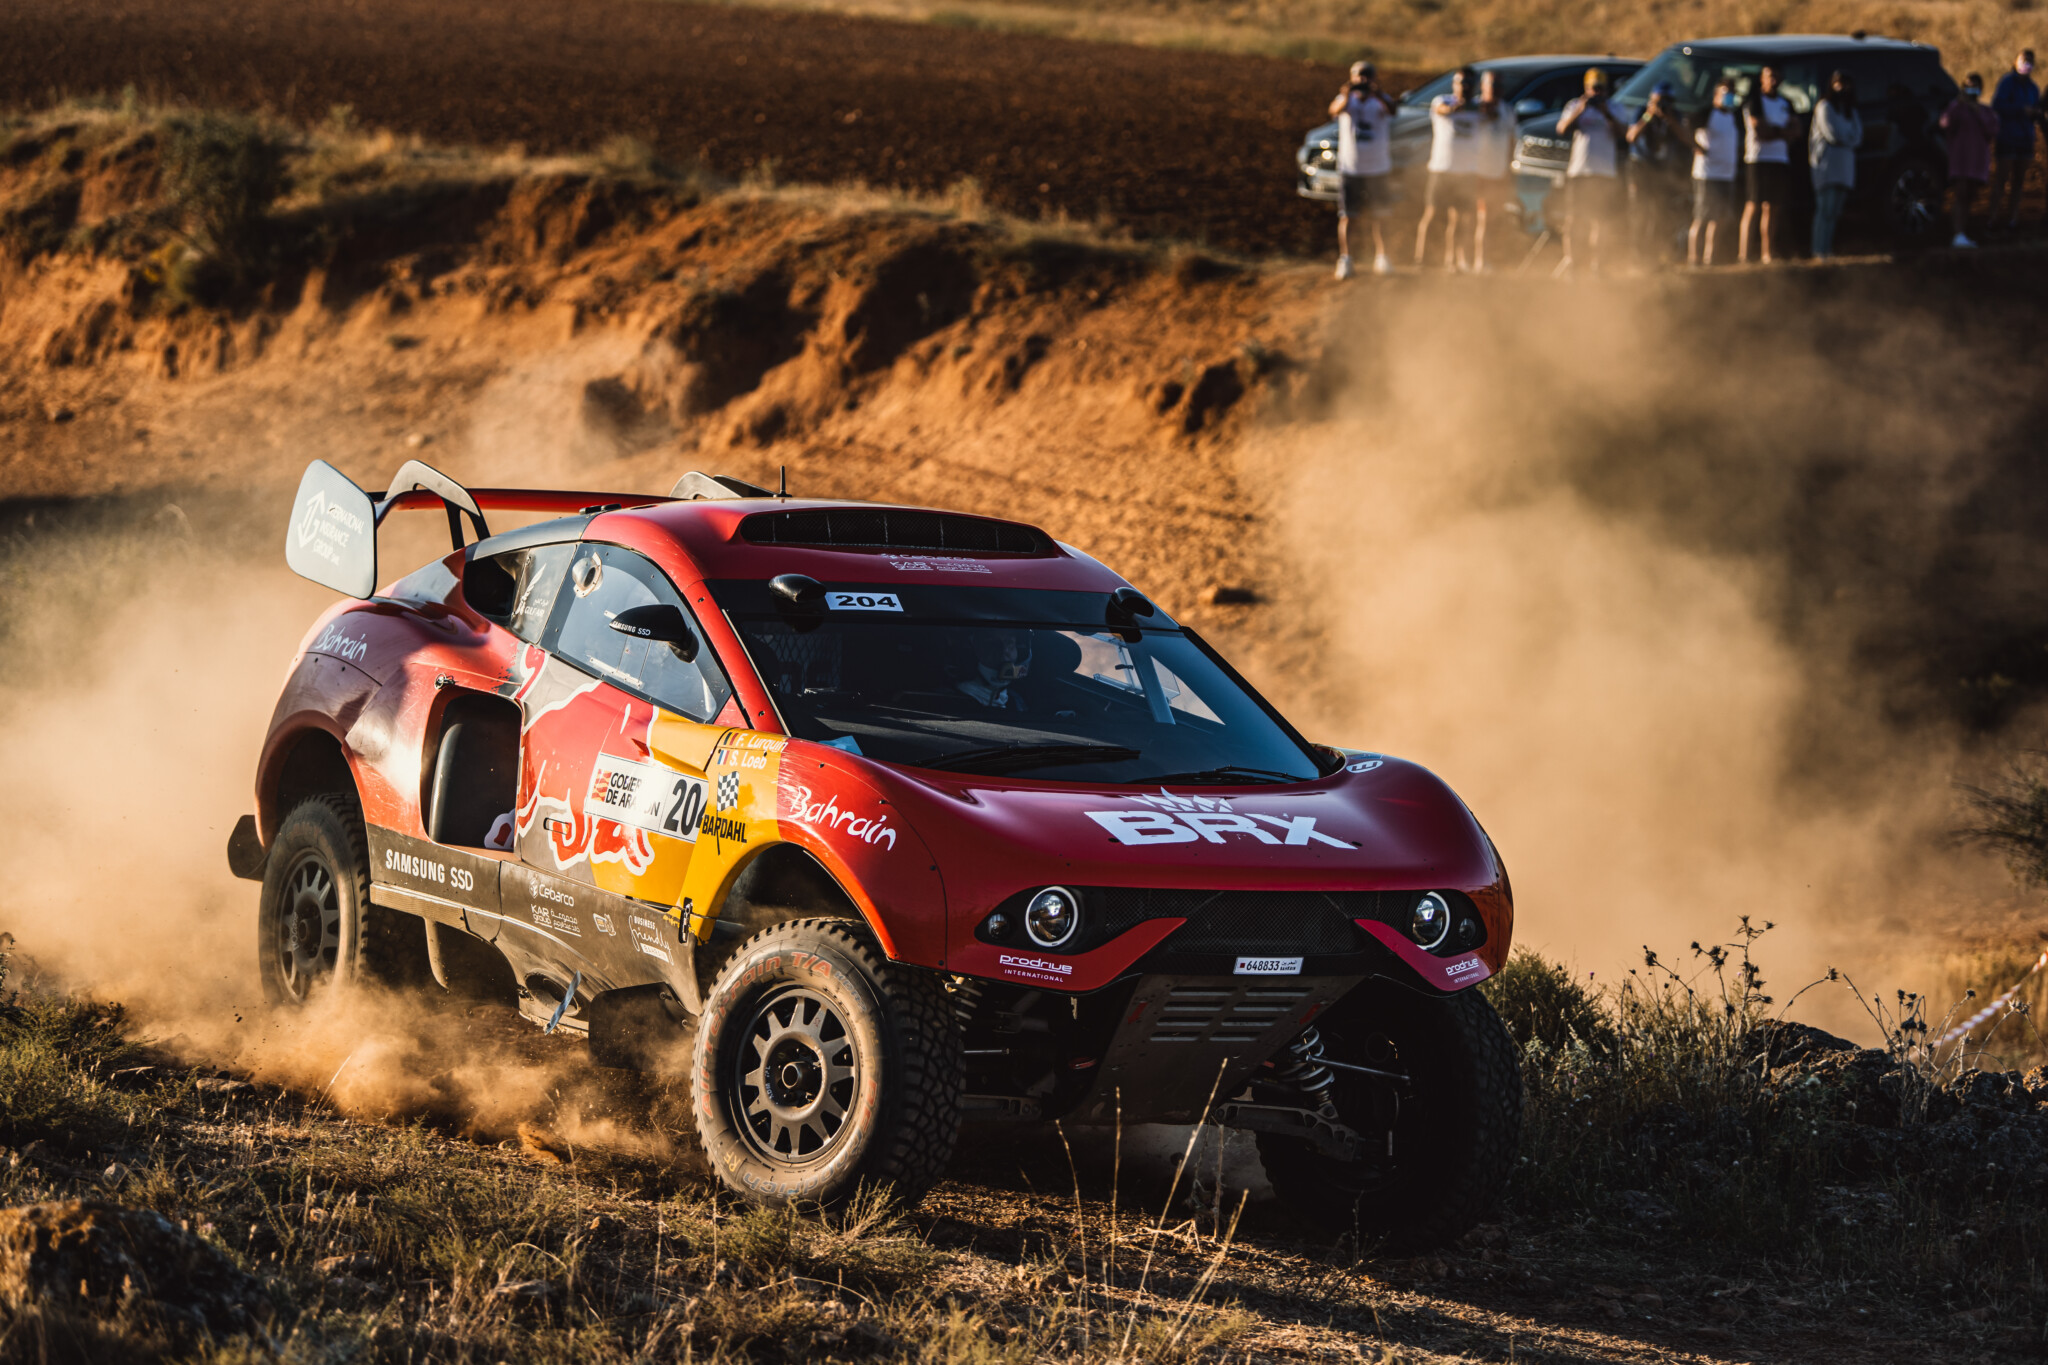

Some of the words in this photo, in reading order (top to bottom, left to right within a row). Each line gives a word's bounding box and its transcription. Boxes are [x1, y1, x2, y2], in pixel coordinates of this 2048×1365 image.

[835, 594, 897, 607] 204
[612, 620, 637, 633] SAMSUNG
[315, 624, 368, 662] Bahrain
[735, 733, 745, 747] F.
[747, 734, 789, 752] Lurquin
[729, 752, 739, 767] S.
[740, 754, 767, 770] Loeb
[610, 772, 648, 793] GOBIER
[605, 788, 619, 805] DE
[788, 785, 897, 851] Bahrain
[701, 814, 748, 844] BARDAHL
[1084, 810, 1359, 850] BRX
[385, 849, 446, 884] SAMSUNG
[450, 866, 474, 891] SSD
[538, 884, 575, 907] Cebarco
[530, 903, 550, 918] KAR
[633, 915, 656, 931] BUSINESS
[628, 914, 675, 967] friendly
[791, 951, 833, 978] T/A
[999, 954, 1073, 975] prodrive
[1246, 960, 1280, 971] 648833
[1445, 958, 1480, 976] prodrive
[1004, 968, 1064, 983] INTERNATIONAL
